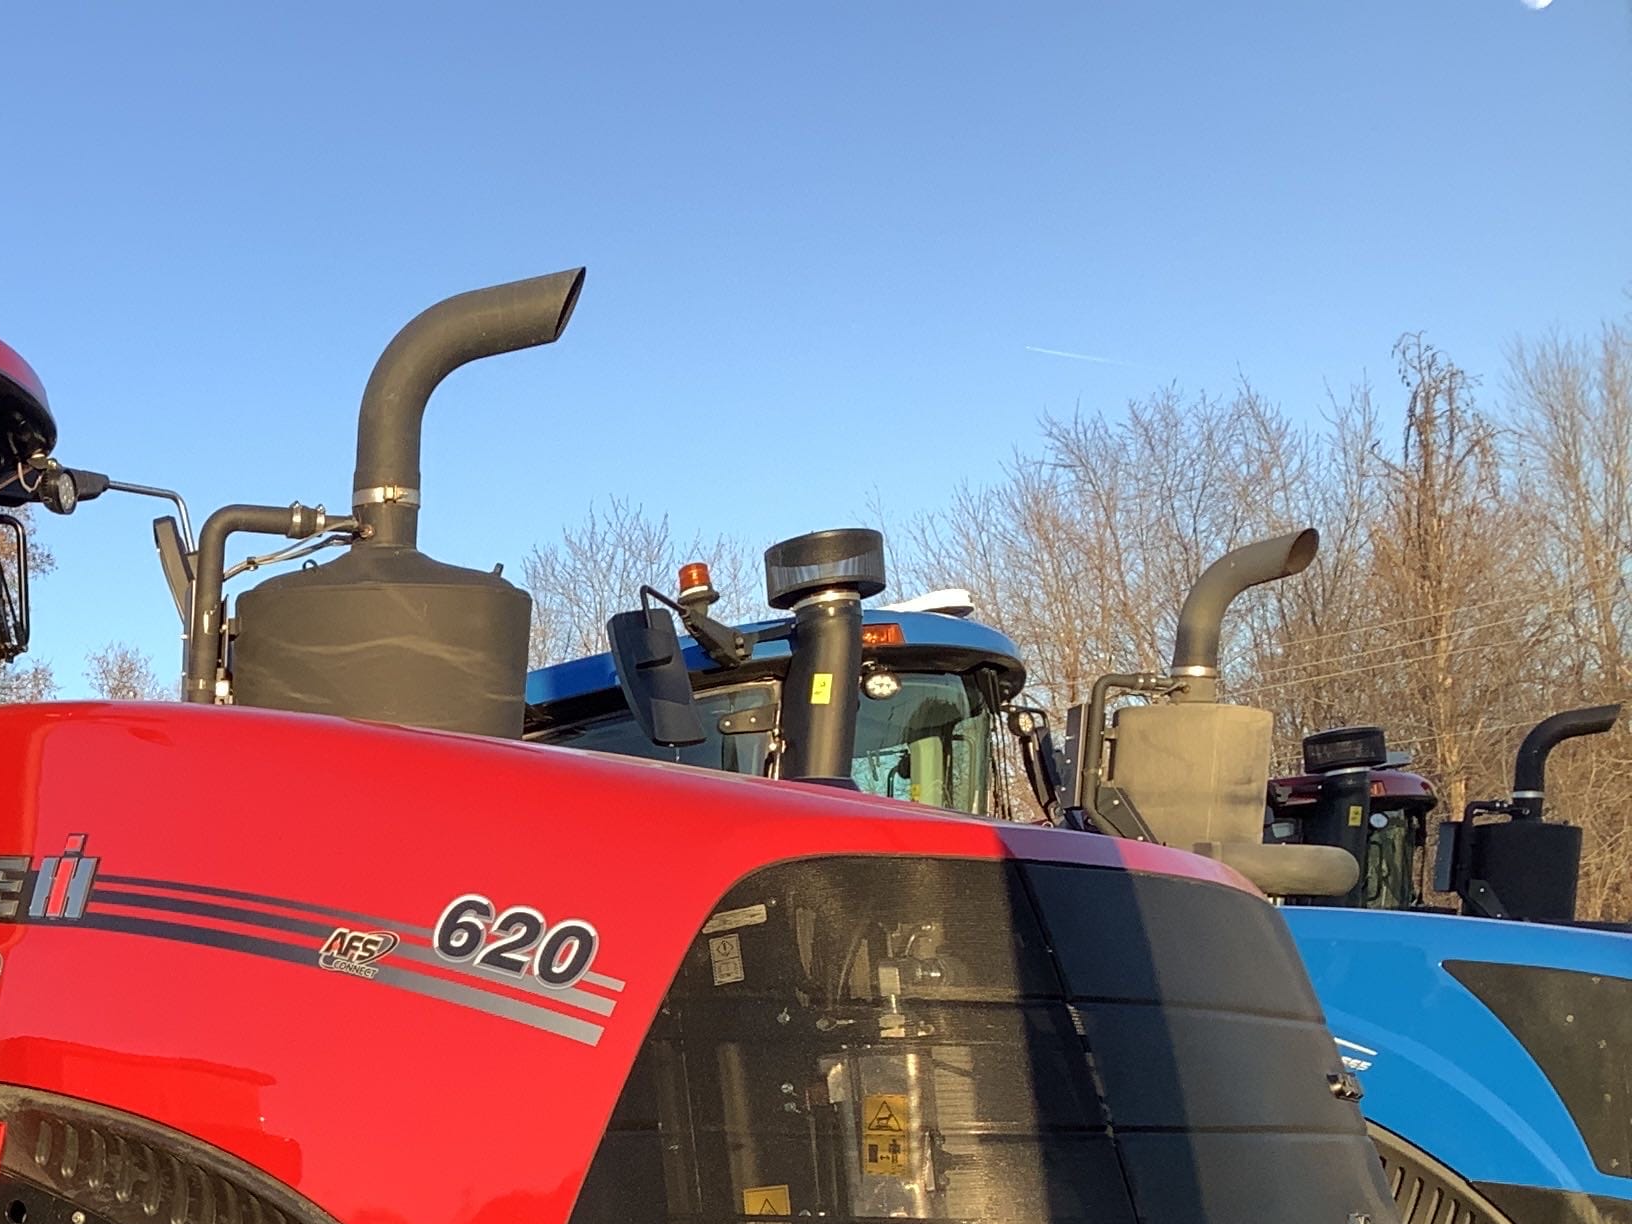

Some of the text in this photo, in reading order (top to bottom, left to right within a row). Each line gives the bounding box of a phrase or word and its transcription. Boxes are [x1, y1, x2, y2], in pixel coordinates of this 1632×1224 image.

[319, 928, 385, 962] AFS
[432, 893, 599, 990] 620
[332, 960, 379, 979] CONNECT
